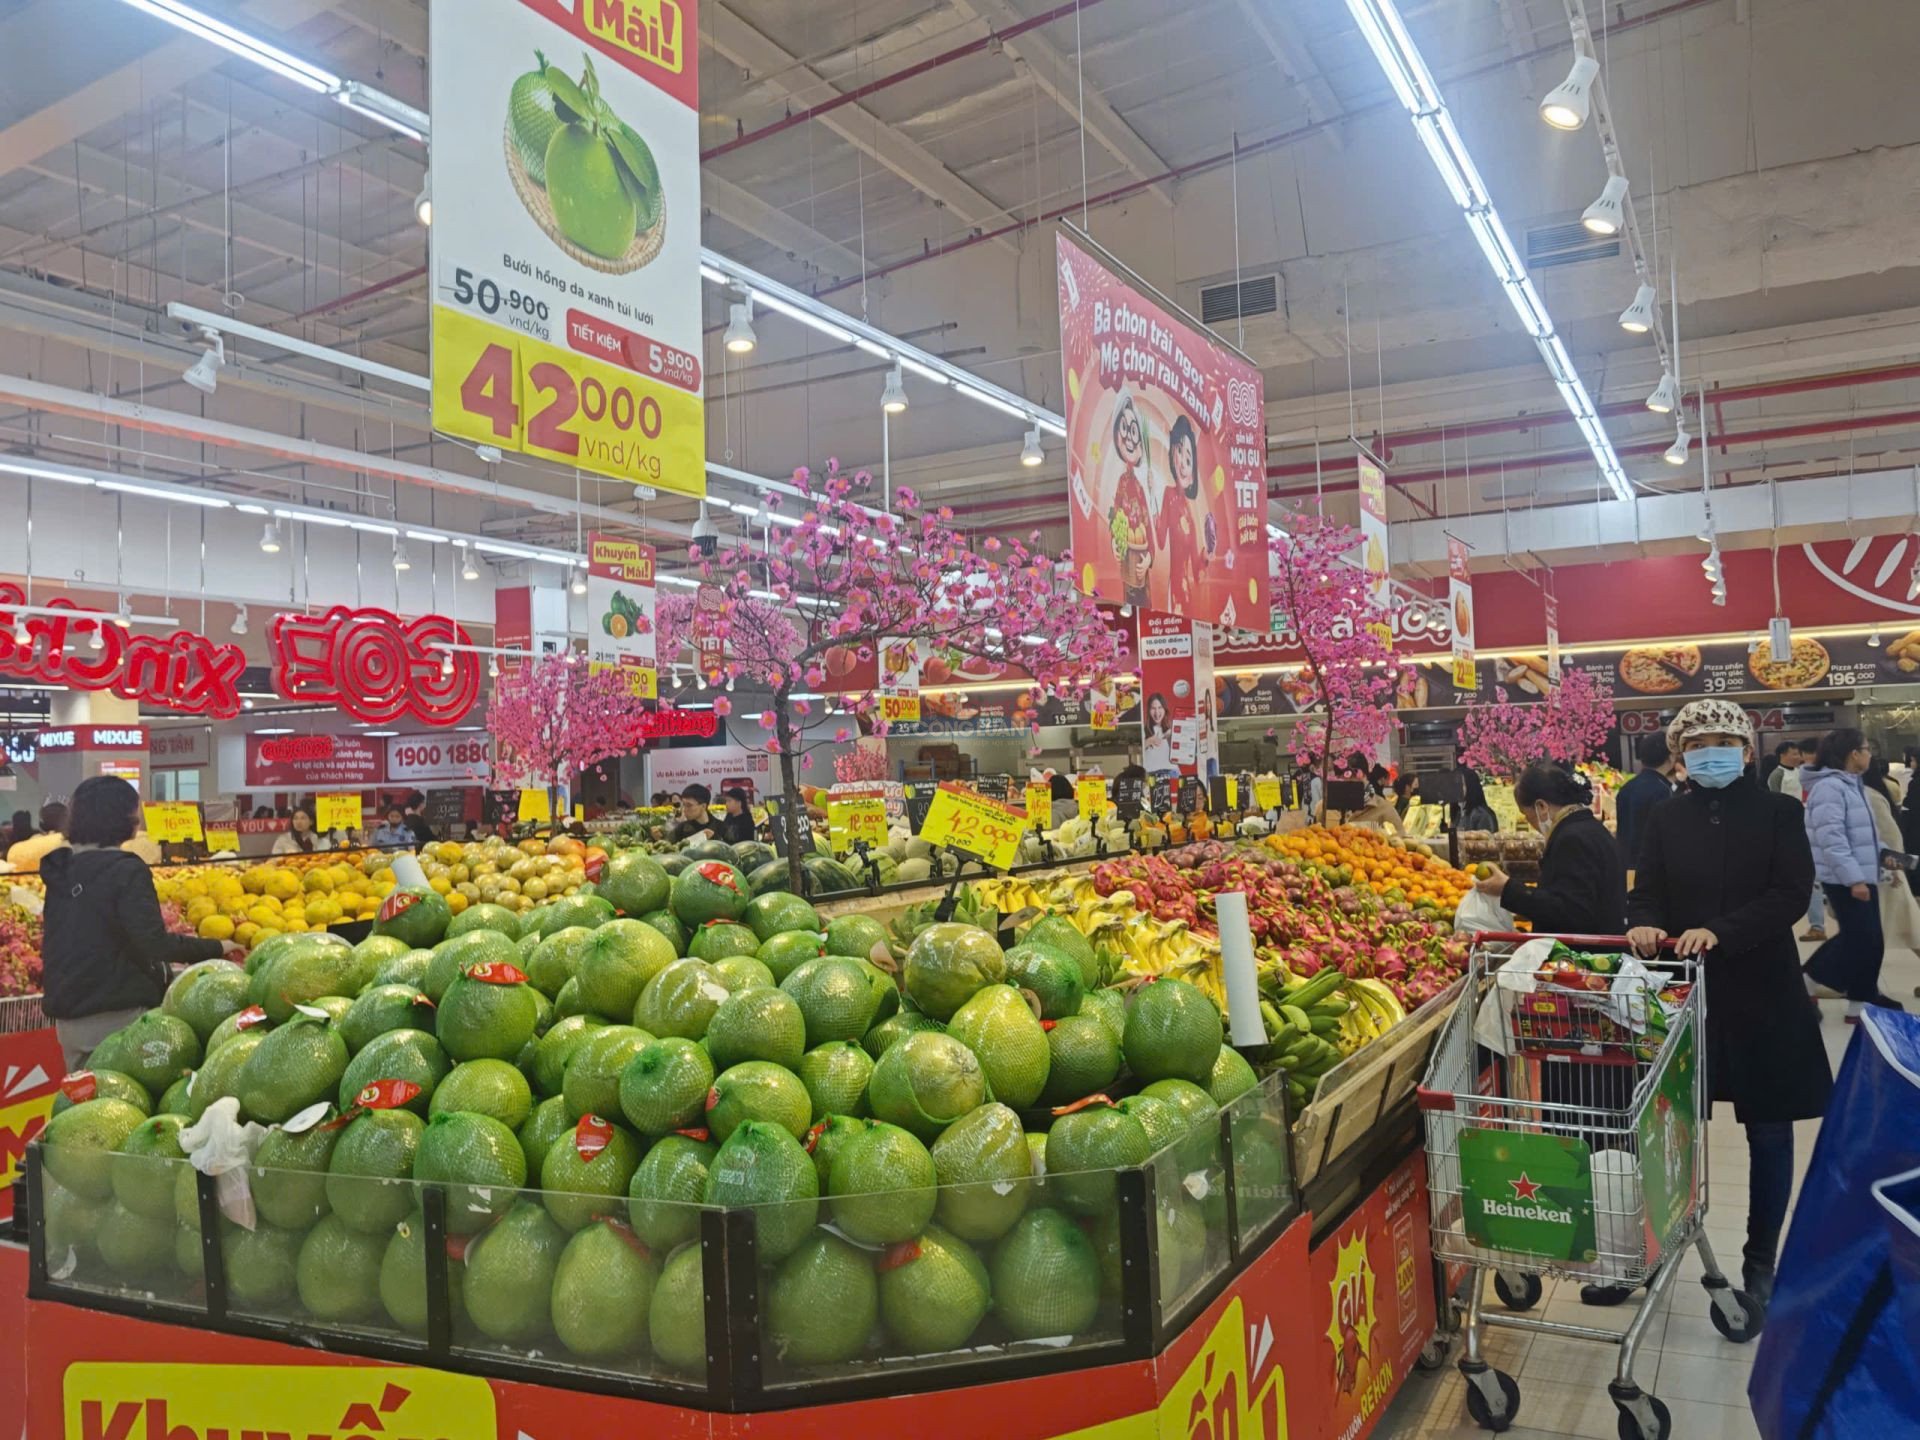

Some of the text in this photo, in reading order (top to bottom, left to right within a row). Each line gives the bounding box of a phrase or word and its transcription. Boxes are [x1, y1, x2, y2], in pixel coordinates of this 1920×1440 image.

[593, 0, 675, 66] Mãi!
[503, 253, 654, 326] Bưởi hồng da xanh túi lưới
[509, 314, 550, 341] vnd/kg
[572, 321, 621, 352] TIẾT KIỆM
[1094, 297, 1110, 336] Bà
[1150, 319, 1173, 356] trái
[1175, 350, 1204, 392] ngọt
[663, 367, 693, 385] vnd/kg
[1101, 342, 1210, 426] Mẹ chọn rau xanh
[585, 436, 662, 479] vnd/kg
[1231, 447, 1260, 470] MỌI GU
[1235, 470, 1259, 508] TẾT
[595, 546, 637, 560] Khuyến
[626, 562, 649, 579] Mãi!
[1145, 648, 1178, 657] 10.000
[1727, 669, 1743, 677] giác
[1621, 710, 1662, 732] 03
[40, 731, 75, 748] MIXUE
[93, 730, 143, 745] MIXUE
[394, 745, 441, 767] 1900
[321, 771, 343, 780] Khách
[344, 771, 364, 781] Hàng
[241, 819, 264, 832] YOU
[1482, 1198, 1573, 1225] Heineken
[1336, 1257, 1368, 1327] GIÁ
